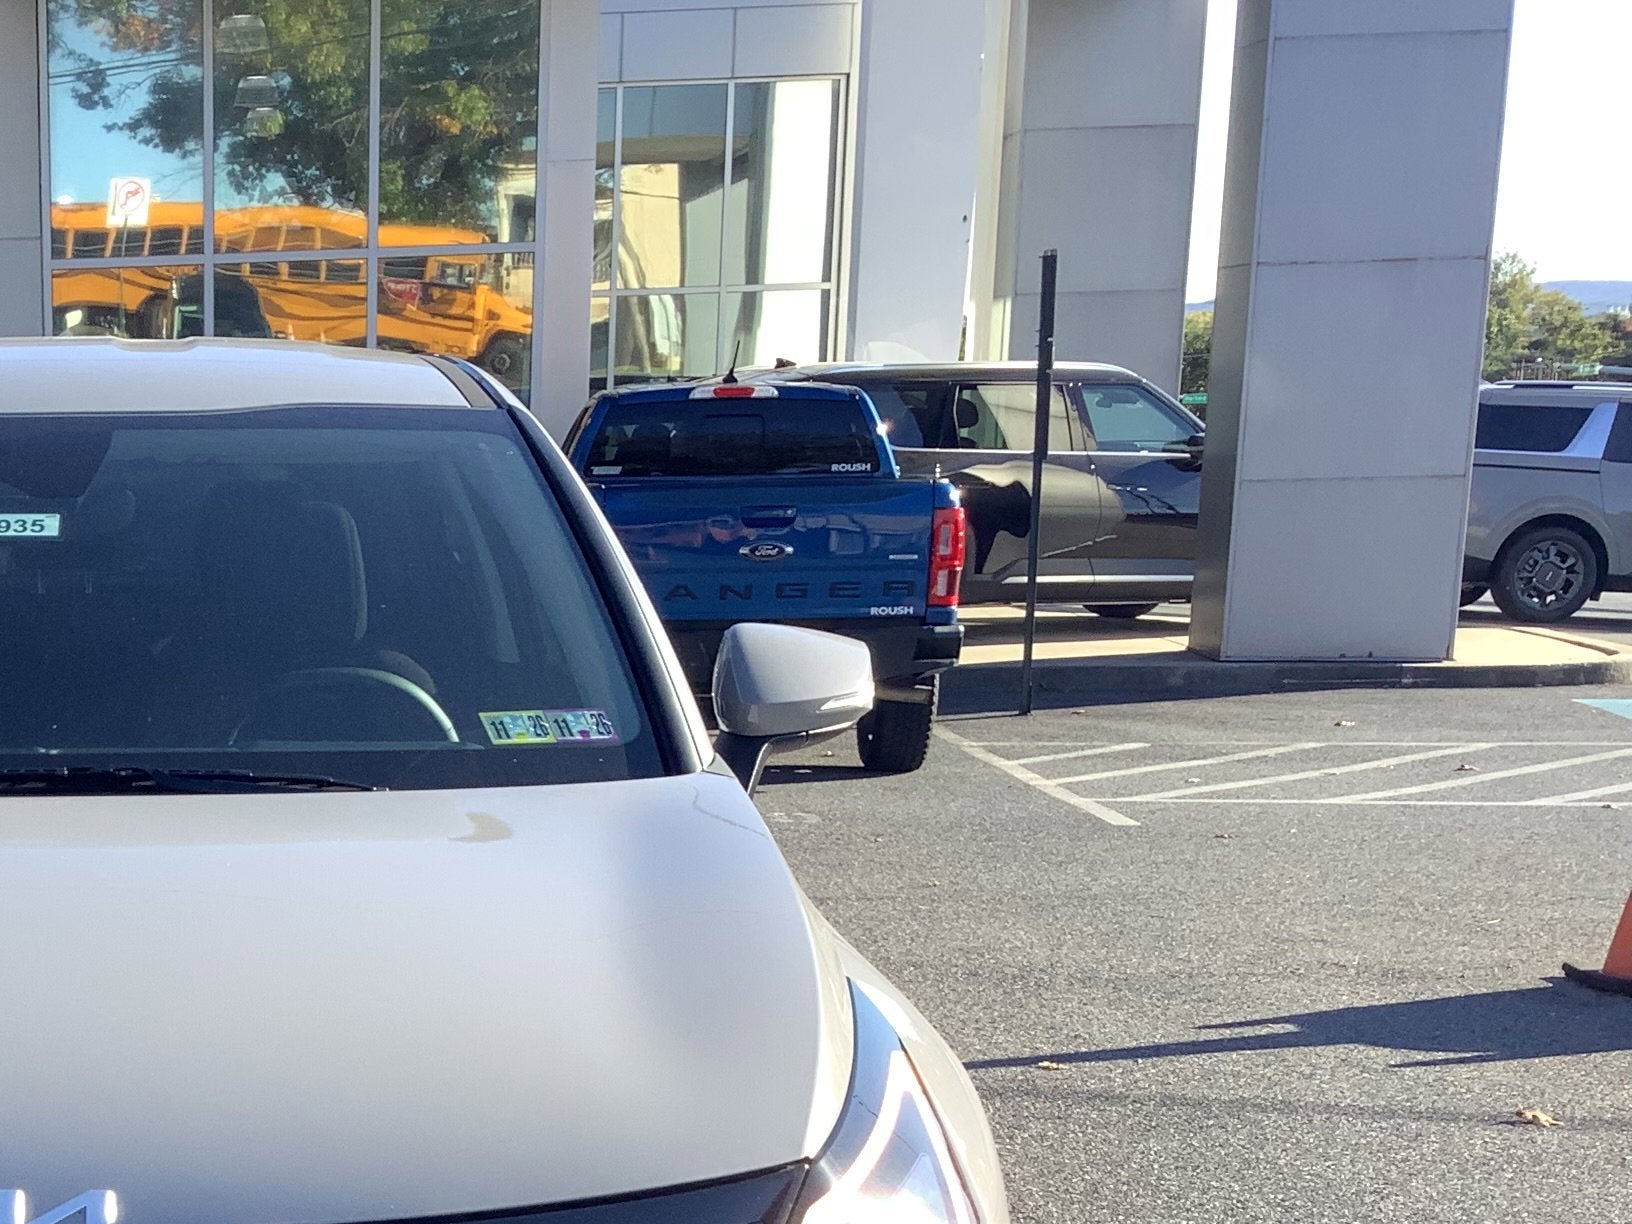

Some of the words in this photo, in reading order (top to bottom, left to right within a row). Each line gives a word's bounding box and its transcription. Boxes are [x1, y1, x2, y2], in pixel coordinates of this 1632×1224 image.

[831, 463, 871, 472] ROUSH
[755, 545, 779, 556] Ford
[663, 580, 915, 601] ANGER
[870, 606, 914, 616] ROUSH
[490, 719, 511, 739] 11
[528, 714, 550, 738] 26
[553, 717, 574, 738] 11
[590, 713, 612, 735] 26
